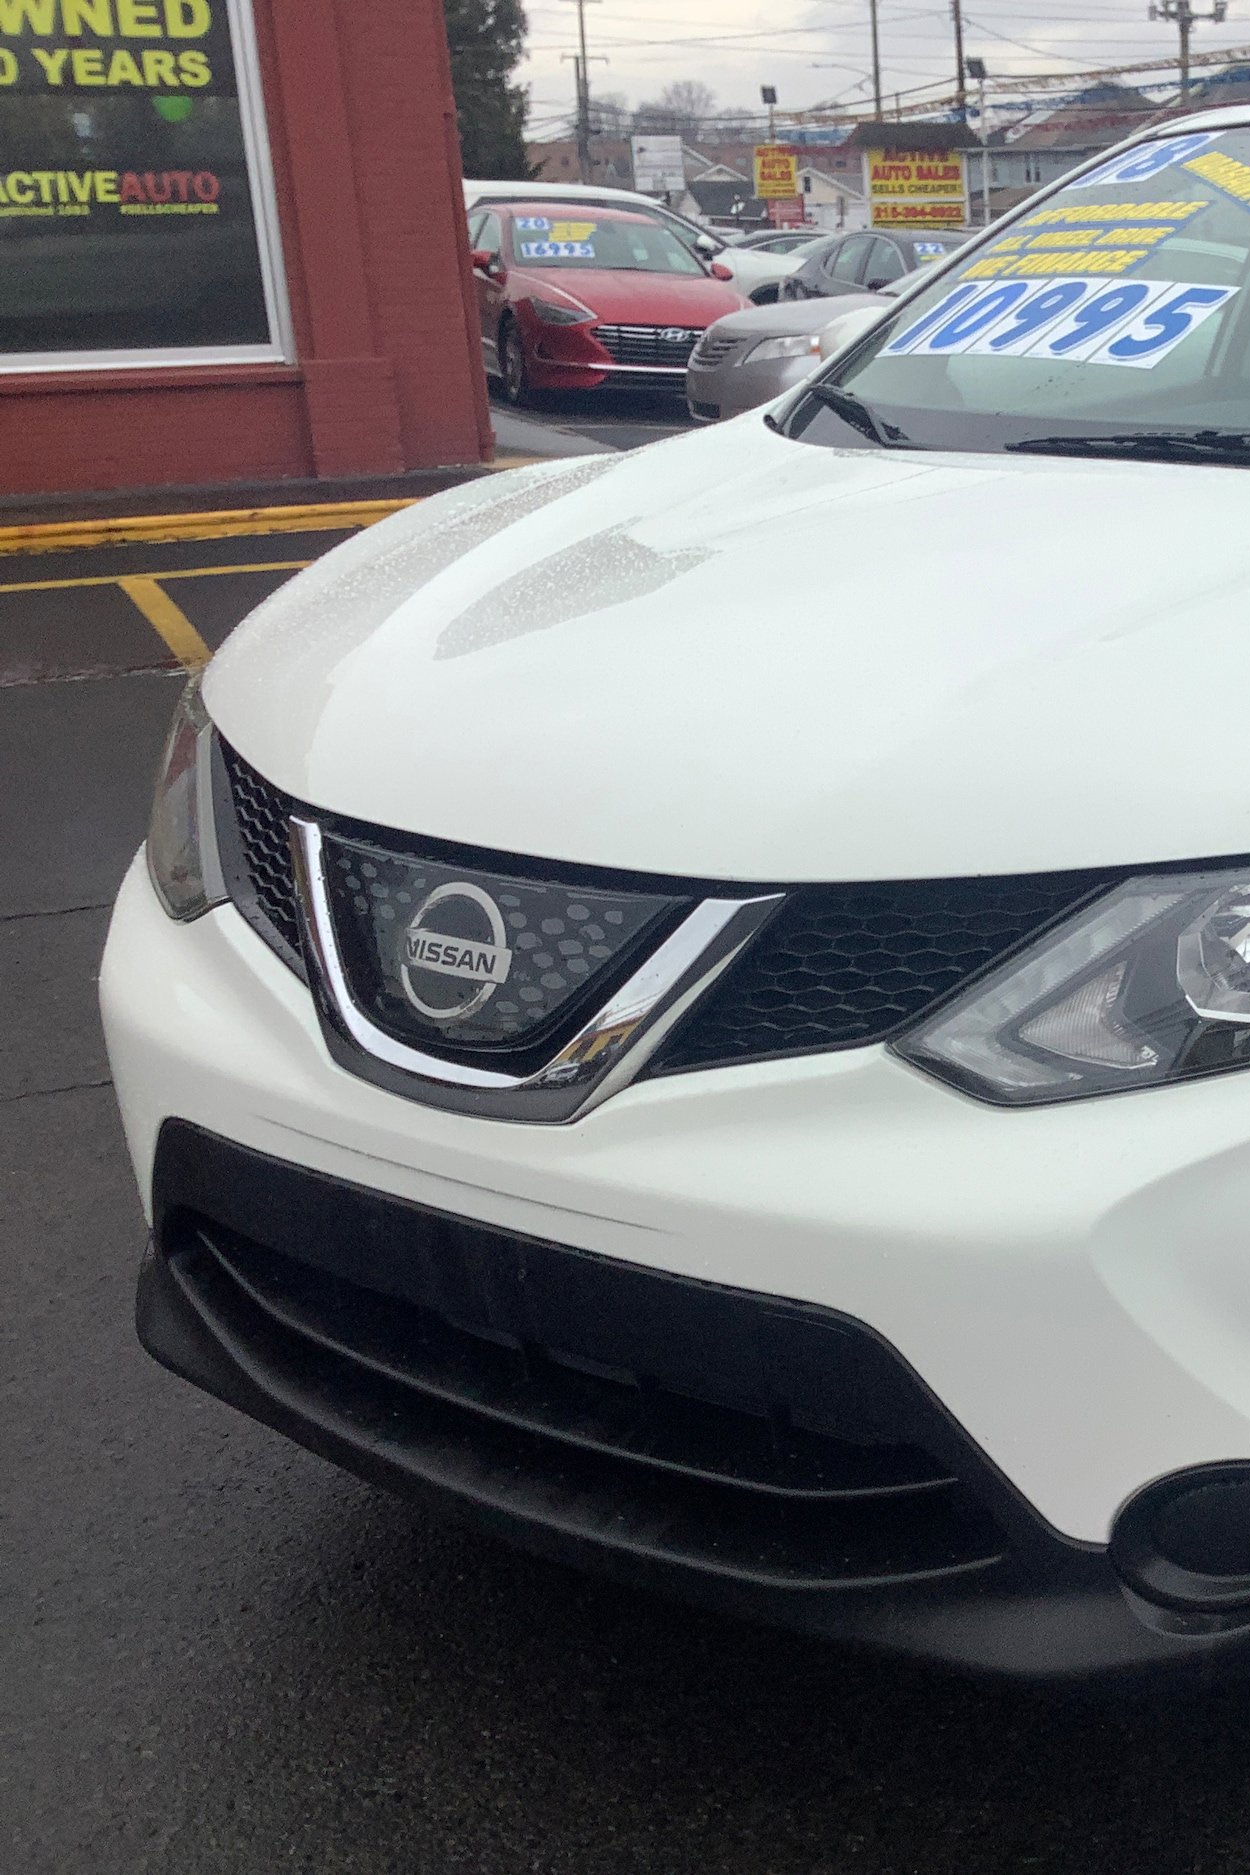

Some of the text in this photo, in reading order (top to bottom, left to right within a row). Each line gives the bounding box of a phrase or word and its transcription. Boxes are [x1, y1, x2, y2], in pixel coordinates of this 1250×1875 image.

[31, 48, 212, 87] YEARS
[872, 164, 961, 181] AUTO SALES
[872, 184, 905, 194] SELLS
[521, 218, 546, 229] 20
[524, 242, 591, 256] 16995
[1024, 229, 1104, 249] WHEEL
[1094, 227, 1176, 245] DRIVE
[958, 250, 1149, 279] WE FINANCE
[887, 282, 1230, 358] 10995
[406, 936, 497, 974] NISSAN
